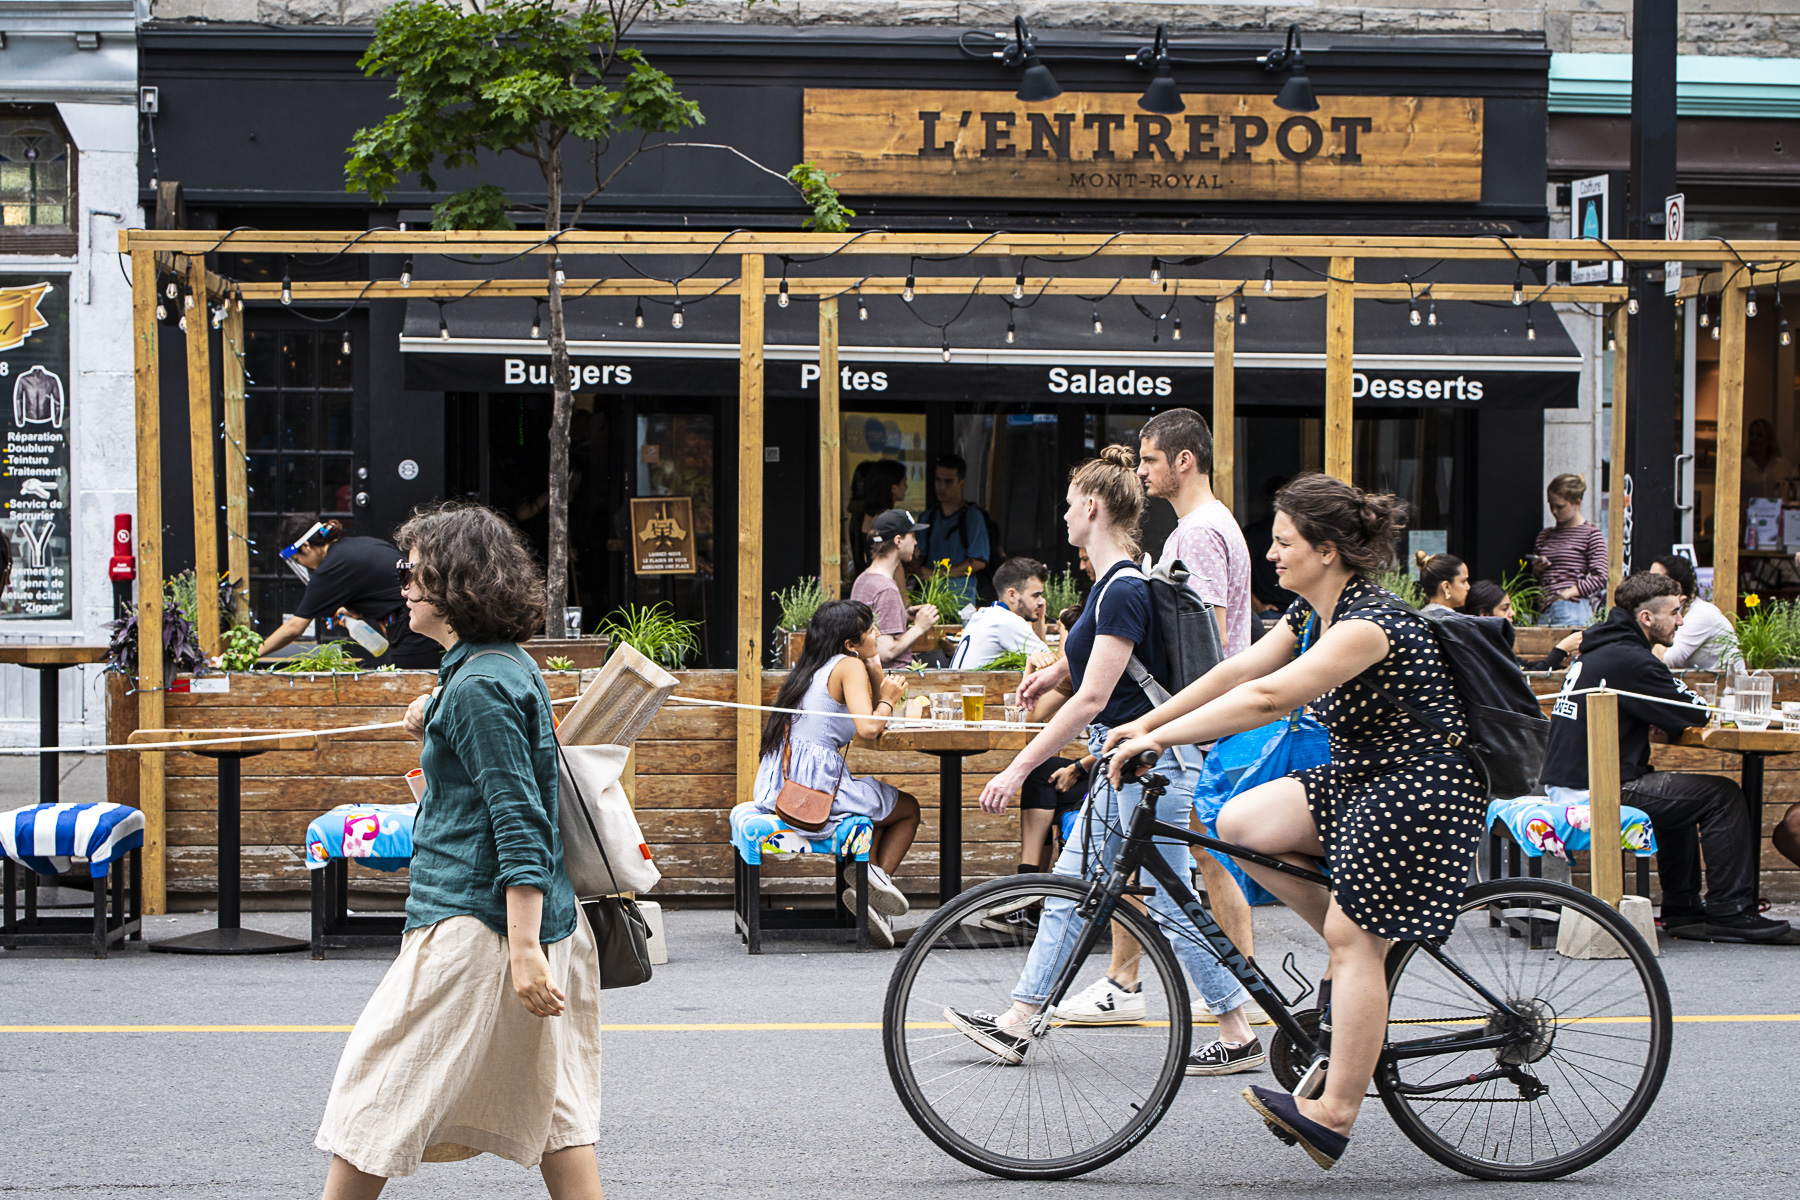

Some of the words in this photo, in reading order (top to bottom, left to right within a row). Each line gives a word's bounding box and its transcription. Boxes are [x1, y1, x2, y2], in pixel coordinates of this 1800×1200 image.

[918, 110, 1372, 163] L'ENTREPOT
[1069, 172, 1223, 190] MONT-ROYAL
[504, 359, 632, 390] Bugers
[801, 363, 889, 391] Ptes
[1048, 367, 1172, 396] Salades
[1352, 373, 1484, 401] Desserts
[7, 432, 64, 443] Réparation
[7, 443, 55, 453] Doublure
[7, 455, 49, 465] Teinture
[7, 466, 62, 476] Traitement
[9, 499, 48, 509] Service
[49, 499, 63, 509] de
[9, 511, 55, 520] Serrurier
[51, 566, 64, 576] de
[20, 580, 49, 590] genre
[51, 578, 64, 588] de
[36, 590, 64, 600] éclair
[1183, 901, 1272, 994] GIANT
